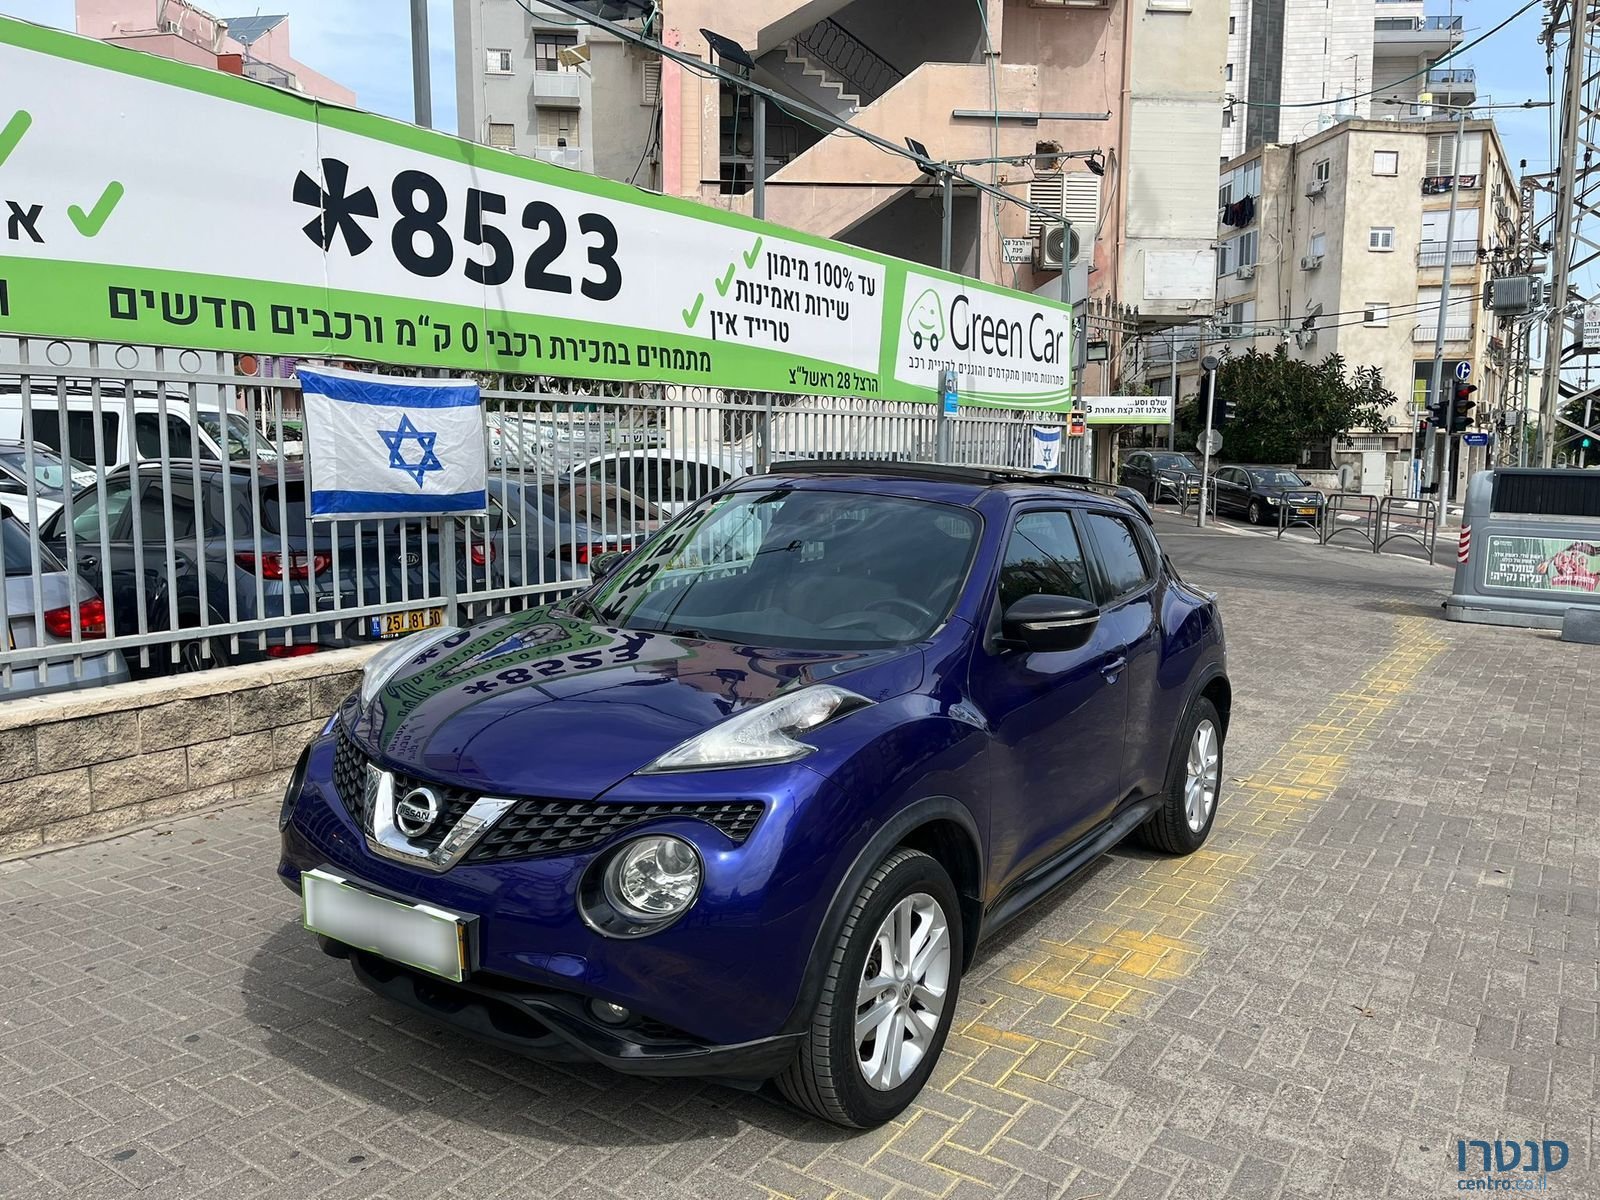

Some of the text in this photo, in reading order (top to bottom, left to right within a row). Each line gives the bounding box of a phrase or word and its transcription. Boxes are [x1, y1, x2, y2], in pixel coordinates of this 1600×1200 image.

[767, 252, 875, 297] עד 100% מימון
[108, 285, 256, 332] חדשים
[736, 280, 849, 321] שירות ואמינות
[270, 304, 384, 344] ורכבים
[710, 310, 789, 343] טרייד אין
[950, 294, 1063, 364] Green Car
[461, 321, 478, 353] 0
[487, 330, 542, 359] רכבי
[549, 336, 631, 366] במכירת
[637, 345, 711, 373] מתמחים
[909, 356, 925, 369] רכב
[958, 362, 985, 376] והוגנים
[837, 371, 850, 389] 28
[853, 372, 878, 392] הרצל
[988, 367, 1020, 382] מתקדמים
[1021, 371, 1038, 384] מימון
[1040, 373, 1064, 385] פתרונות
[1117, 407, 1133, 415] קצת
[1150, 398, 1167, 406] שלם
[1500, 563, 1535, 573] שומרים
[1520, 573, 1542, 584] עליה
[400, 804, 430, 820] NISSAN
